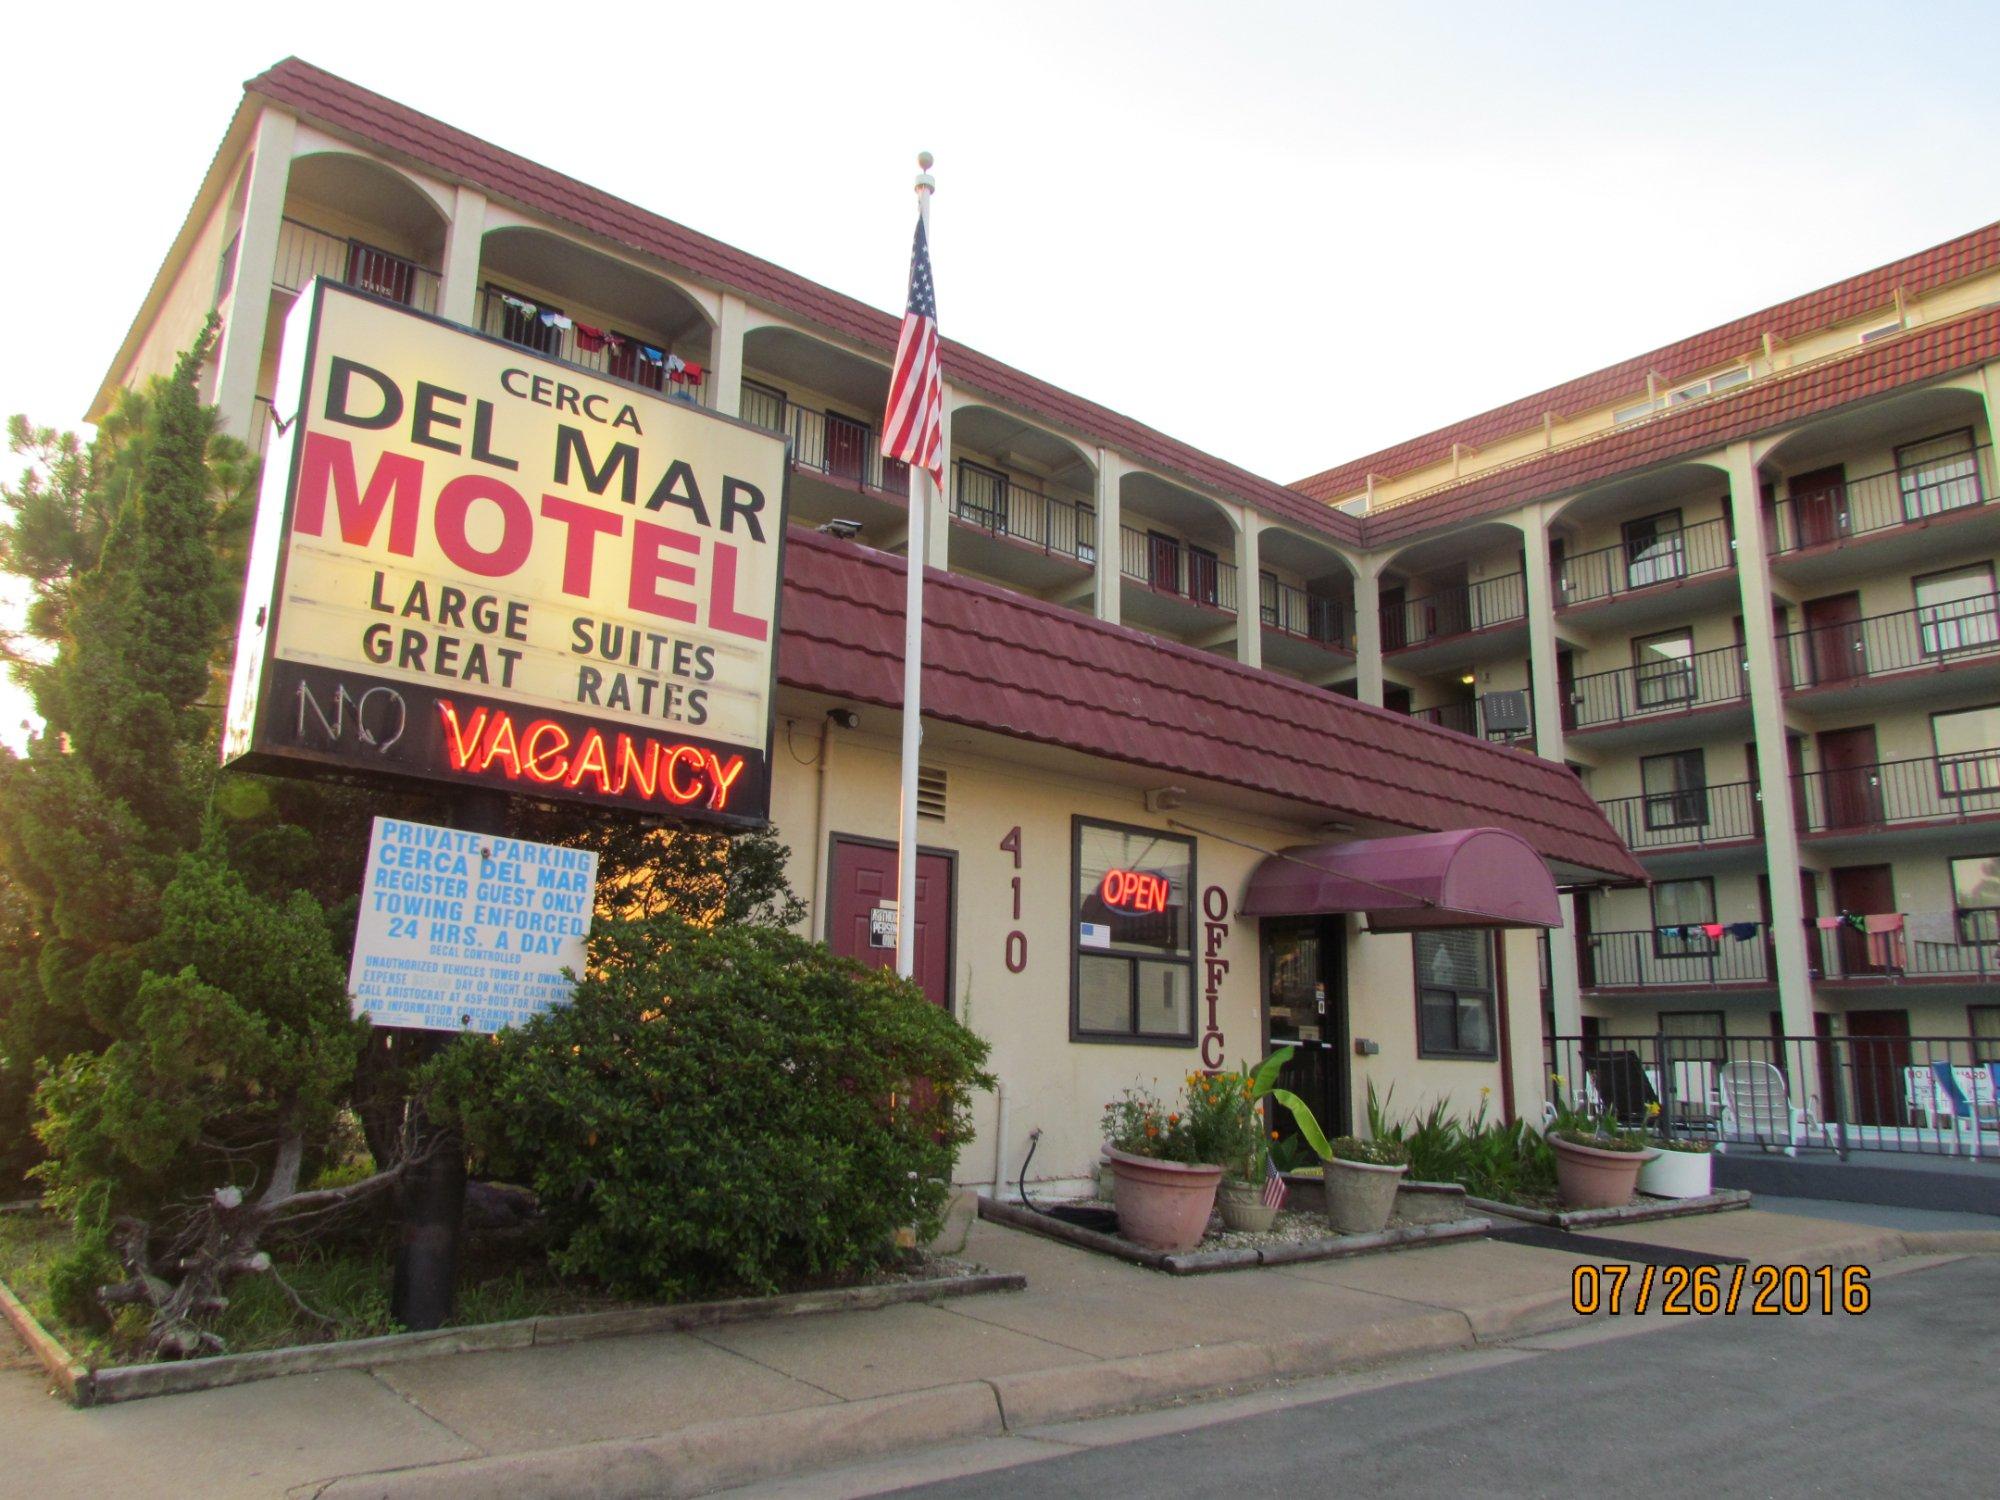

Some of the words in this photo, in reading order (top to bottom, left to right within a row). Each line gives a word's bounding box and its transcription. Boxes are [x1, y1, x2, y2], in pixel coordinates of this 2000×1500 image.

[500, 368, 643, 435] CERCA
[324, 355, 519, 472] DEL
[552, 423, 766, 544] MAR
[293, 430, 768, 642] MOTEL
[370, 571, 529, 641] LARGE
[570, 616, 715, 681] SUITES
[363, 623, 523, 689] GREAT
[577, 665, 709, 726] RATES
[297, 683, 406, 753] NO
[434, 699, 743, 809] VACANCY
[380, 843, 468, 876] CERCA
[480, 859, 526, 885] DEL
[537, 867, 588, 893] MAR
[382, 821, 482, 855] PRIVATE
[493, 839, 590, 872] PARKING
[373, 891, 463, 921] TOWING
[474, 904, 583, 936] ENFORCED
[375, 867, 468, 899] REGISTER
[476, 882, 536, 908] GUEST
[543, 891, 585, 914] ONLY
[1000, 826, 1027, 974] 410
[1102, 867, 1169, 913] OPEN
[388, 917, 418, 939] 24
[430, 922, 482, 947] HRS.
[495, 930, 509, 950] A
[520, 932, 562, 956] DAY
[430, 944, 459, 958] DECAL
[463, 948, 521, 964] CONTROLLED
[363, 970, 407, 985] EXPENSE
[455, 978, 473, 991] DAY
[477, 981, 489, 992] OR
[494, 982, 520, 995] NIGHT
[523, 985, 547, 998] CASH
[365, 955, 438, 973] UNAUTHORIZED
[443, 963, 485, 978] VEHICLES
[490, 967, 520, 981] TOWED
[1201, 885, 1229, 1077] OFFIC
[358, 983, 382, 996] CALL
[513, 998, 529, 1010] FOR
[363, 998, 384, 1011] AND
[387, 1001, 453, 1016] INFORMATION
